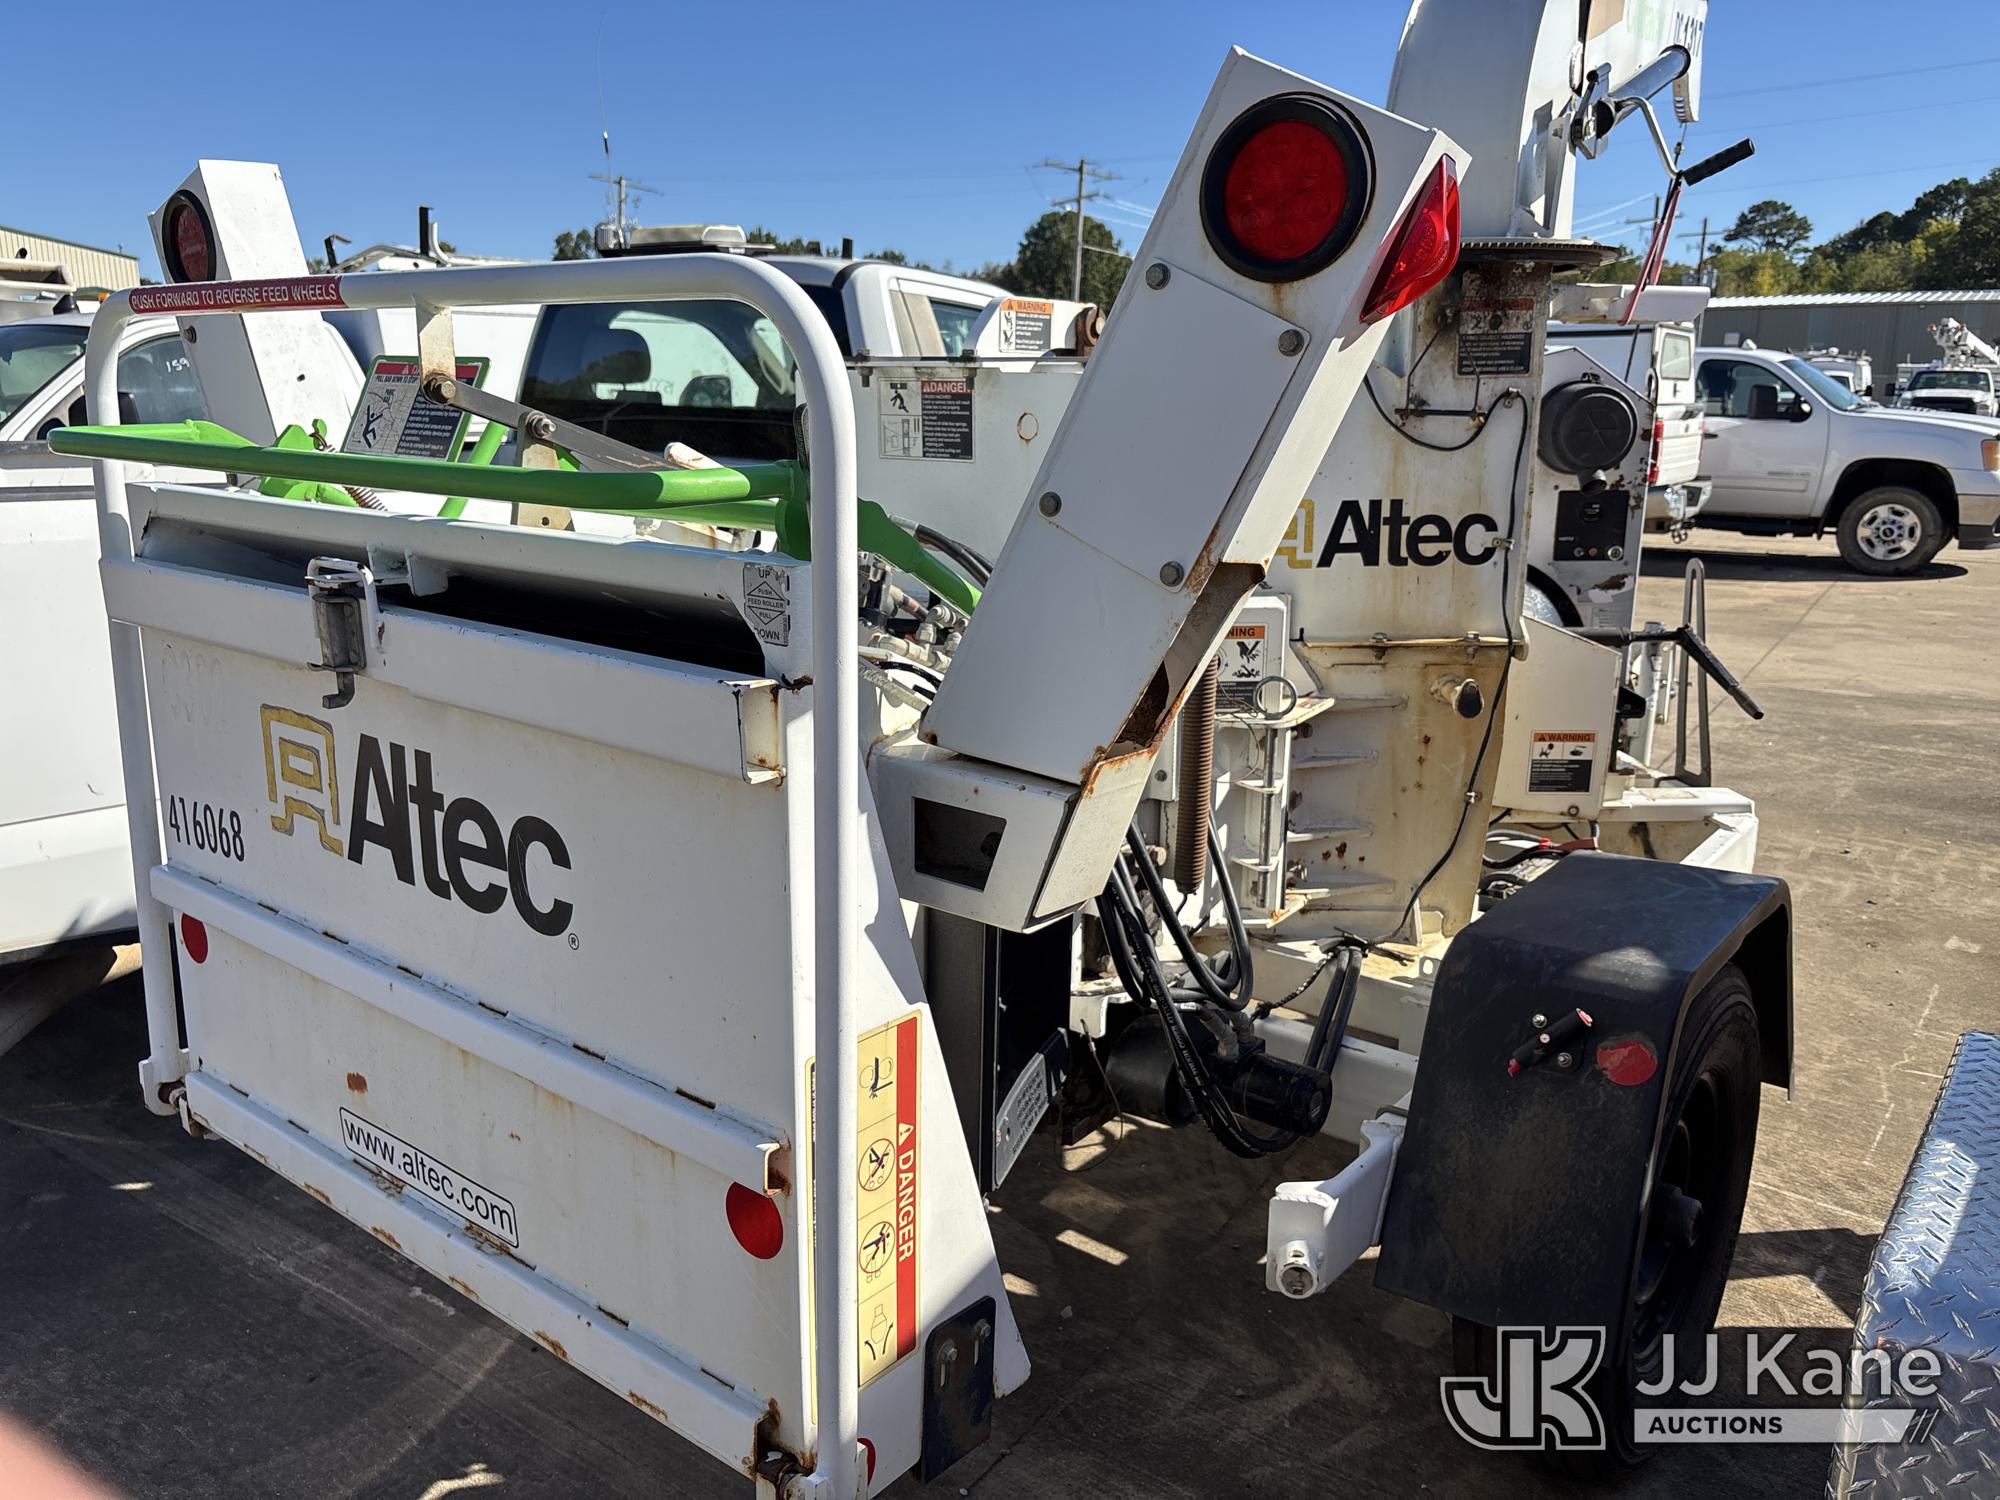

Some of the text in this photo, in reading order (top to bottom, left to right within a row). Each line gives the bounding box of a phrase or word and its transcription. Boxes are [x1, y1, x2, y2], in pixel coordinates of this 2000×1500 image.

[131, 283, 337, 310] PUSH FORWARD TO REVERSE FEED WHEELS
[1017, 301, 1046, 313] WARNING
[1317, 499, 1498, 568] Altec
[758, 568, 771, 579] UP
[758, 588, 773, 596] PUSH
[747, 597, 784, 609] FEED ROLLER
[759, 611, 772, 619] PULL
[1228, 628, 1256, 637] NING
[1548, 733, 1591, 742] WARNING
[169, 794, 245, 862] 416068
[348, 733, 574, 937] Altec
[344, 1118, 514, 1235] www.altec.com
[899, 1149, 915, 1263] DANGER
